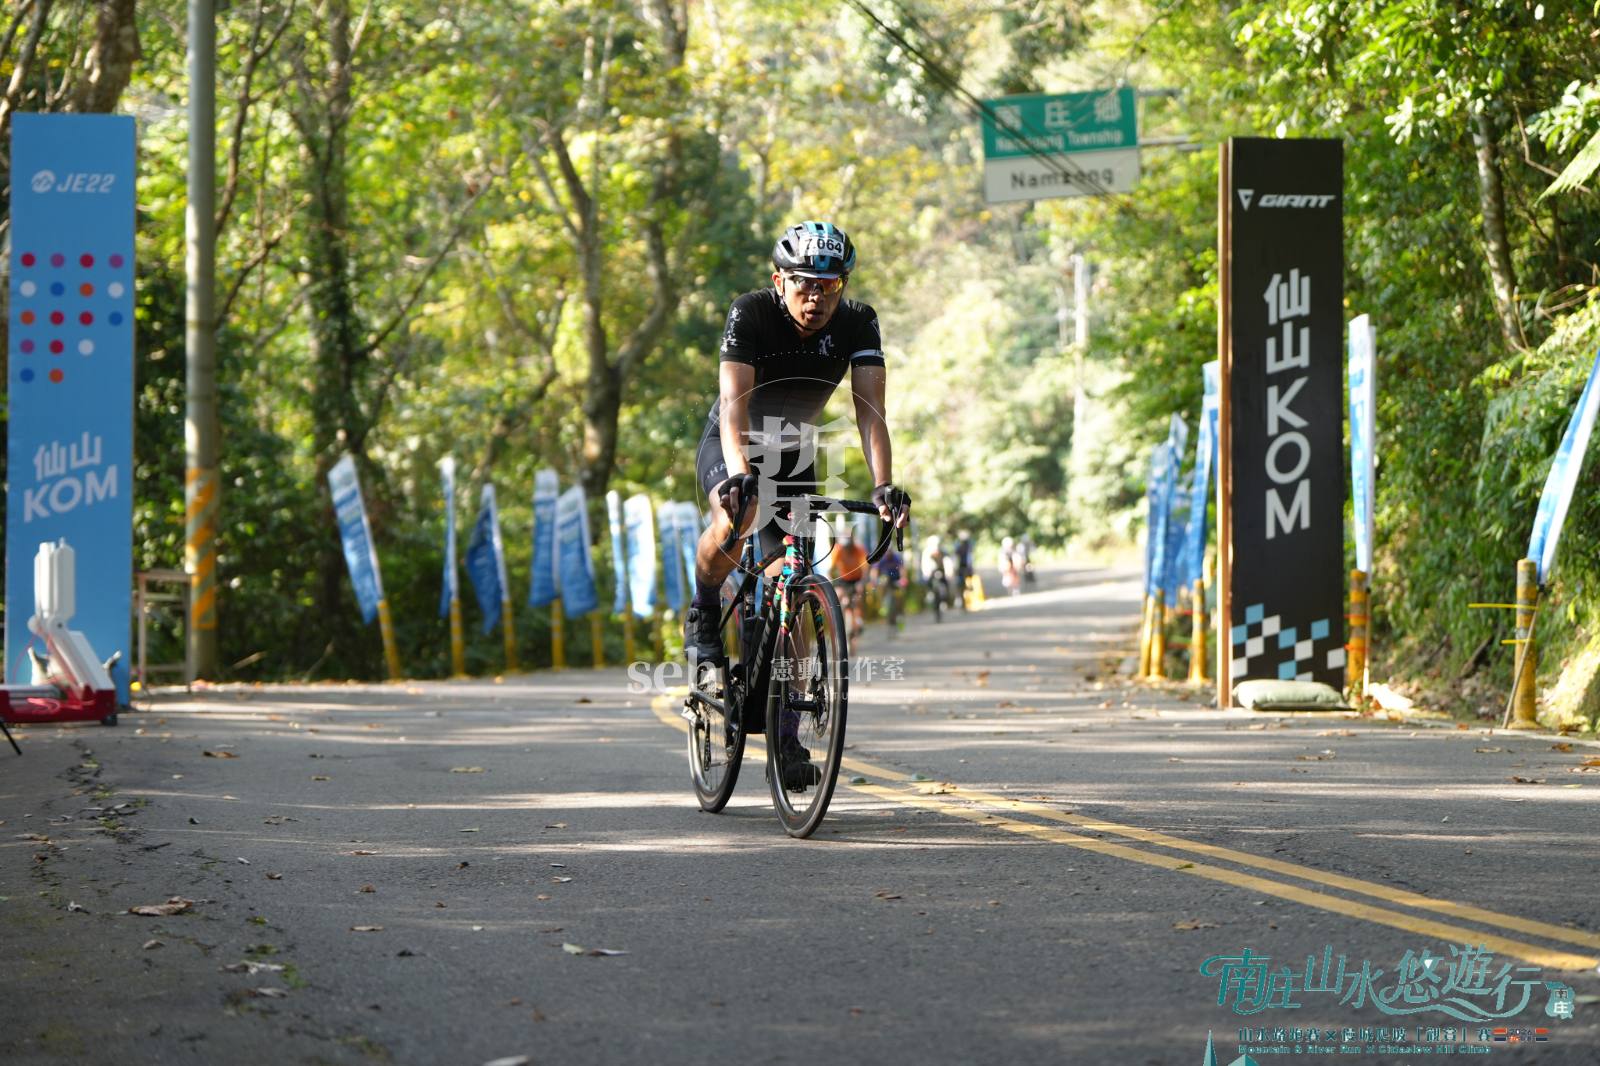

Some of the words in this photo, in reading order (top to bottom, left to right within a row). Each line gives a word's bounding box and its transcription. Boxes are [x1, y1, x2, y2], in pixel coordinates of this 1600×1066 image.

[56, 173, 115, 193] JE22
[1258, 194, 1336, 208] GIANT
[33, 431, 101, 482] 仙山
[23, 463, 117, 523] KOM
